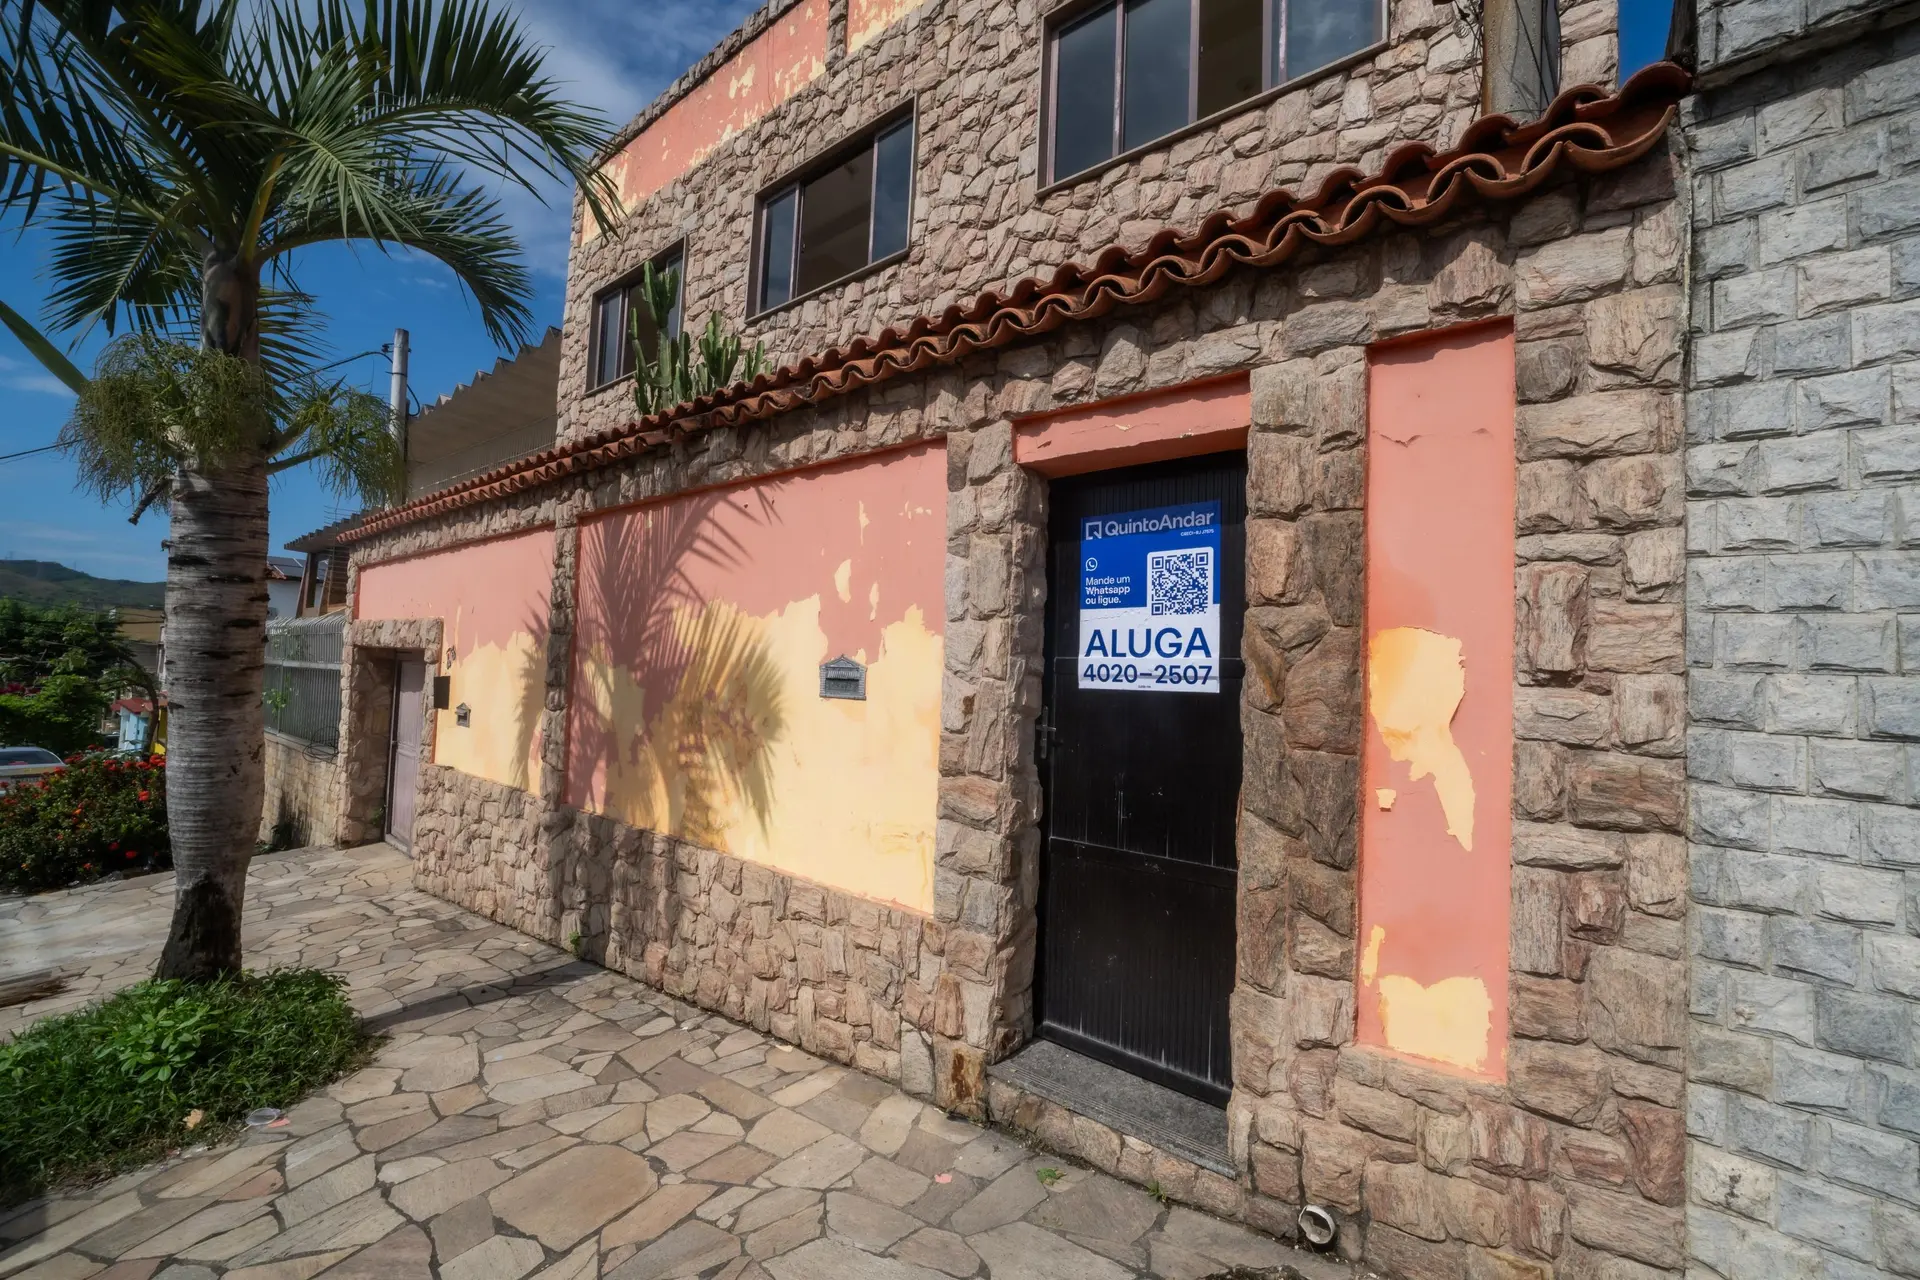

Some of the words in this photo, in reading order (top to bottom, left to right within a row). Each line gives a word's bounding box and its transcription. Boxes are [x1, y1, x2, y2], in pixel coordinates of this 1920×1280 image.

[1105, 511, 1214, 536] QuintoAndar
[1085, 576, 1115, 586] Mande
[1116, 576, 1130, 584] um
[1085, 586, 1131, 596] Whatsapp
[1085, 597, 1097, 605] ou
[1097, 595, 1122, 607] ligue.
[1084, 627, 1212, 658] ALUGA
[1083, 664, 1213, 685] 4020-2507
